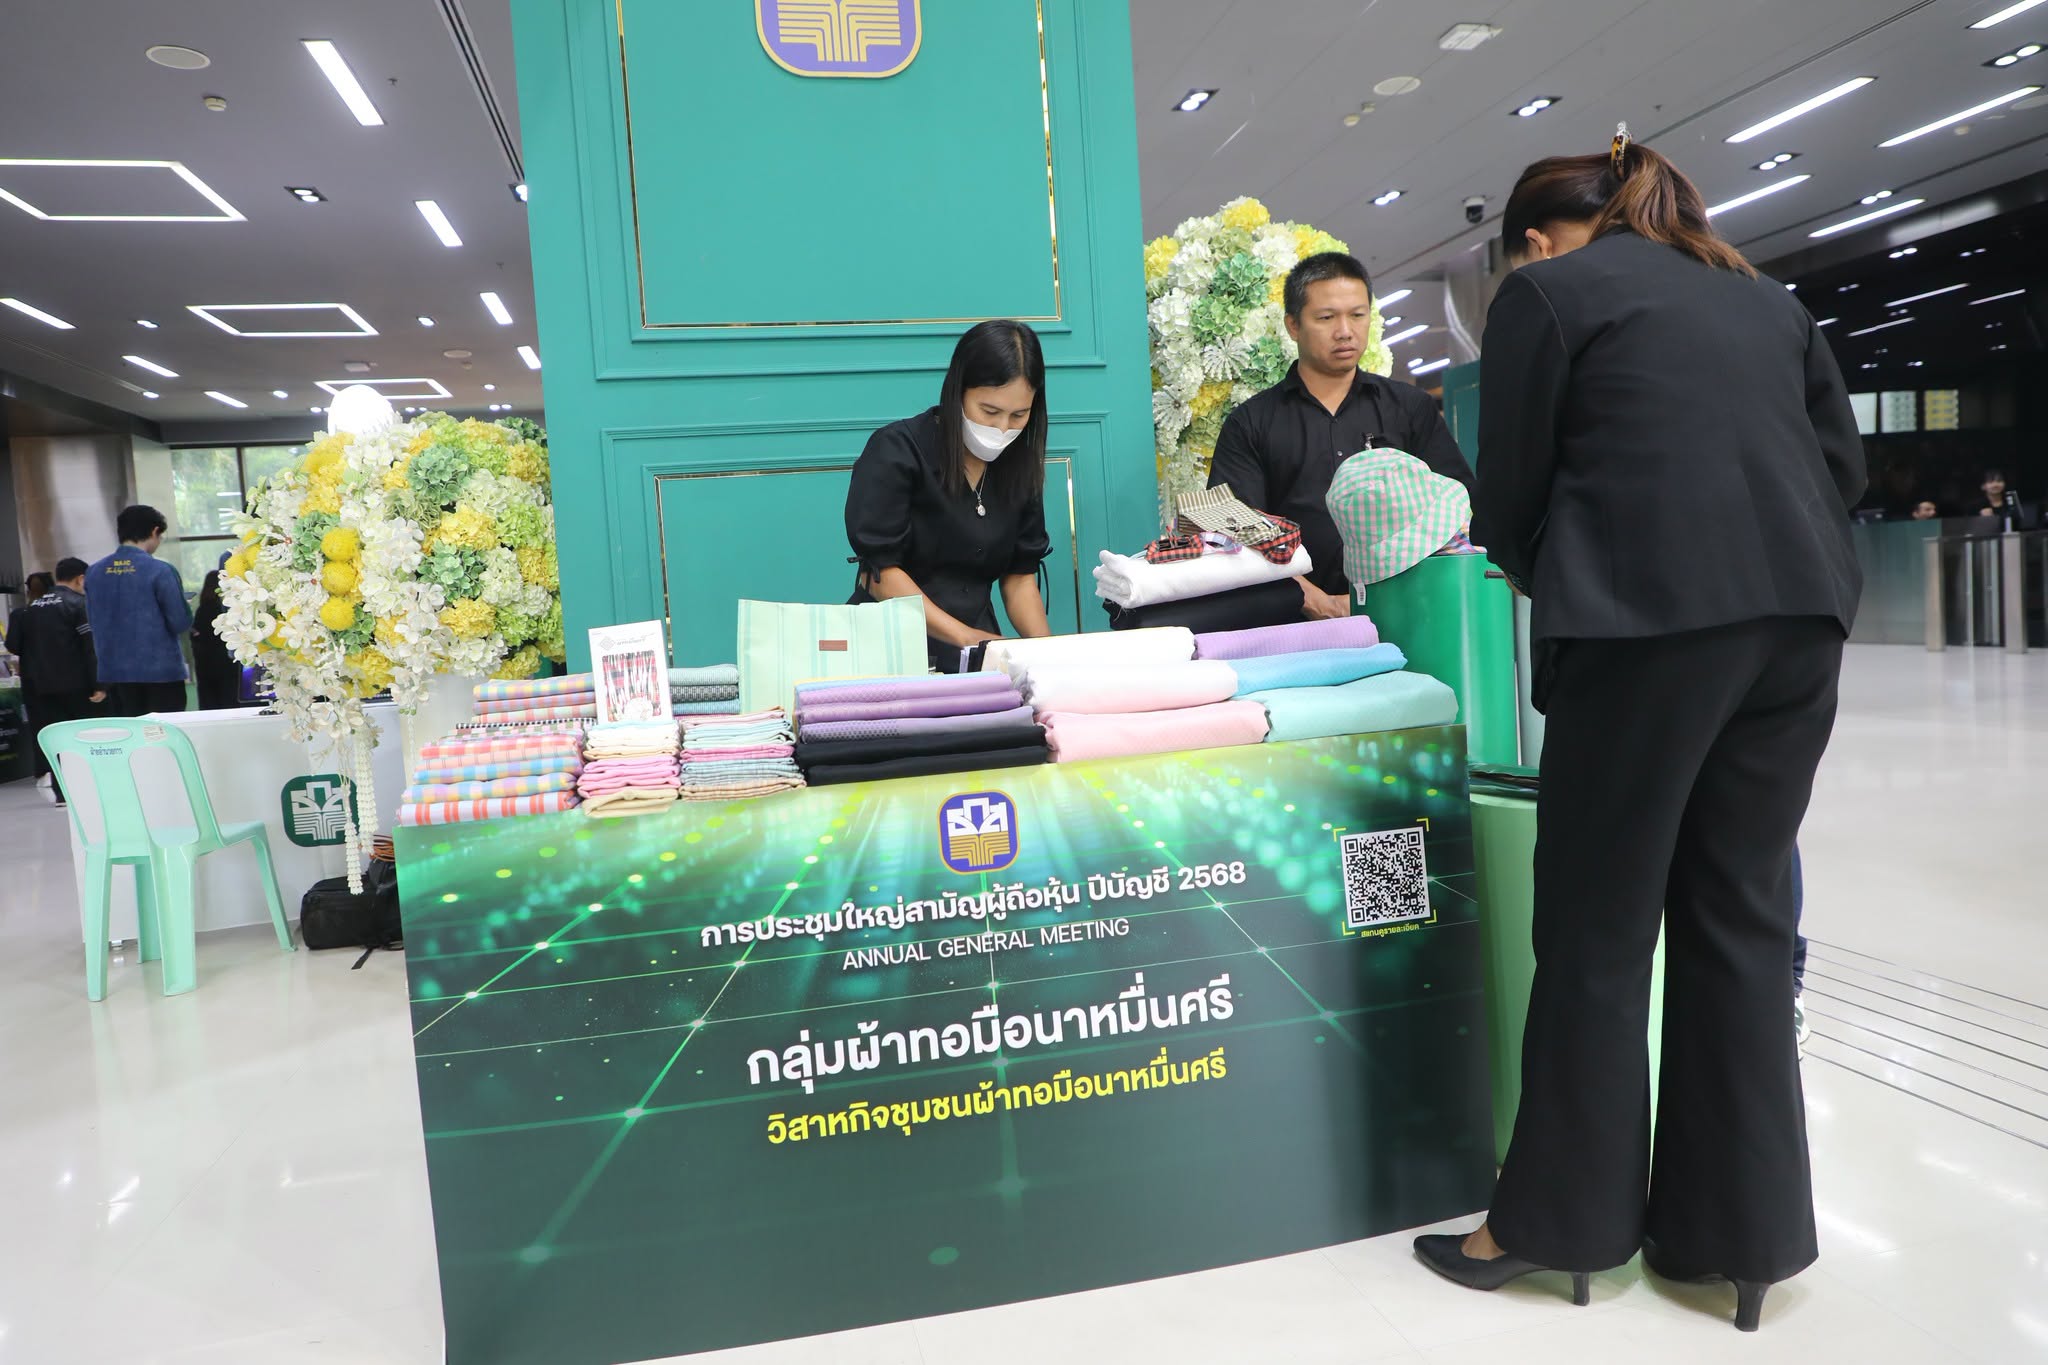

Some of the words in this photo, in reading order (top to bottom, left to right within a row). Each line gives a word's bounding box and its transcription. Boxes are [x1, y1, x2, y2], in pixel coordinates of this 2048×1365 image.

[701, 876, 1081, 947] การประชุมใหญ่สามัญผู้ถือหุ้น
[1088, 866, 1170, 900] ปีบัญชี
[1177, 861, 1246, 891] 2568
[843, 941, 931, 970] ANNUAL
[938, 928, 1034, 959] GENERAL
[1040, 918, 1130, 946] MEETING
[1361, 923, 1420, 938] สแกนดูรายละเอียด
[746, 972, 1234, 1094] กลุ่มผ้าทอมือนาหมื่นศรี
[766, 1047, 1227, 1144] วิสาหกิจชุมชนผ้าทอมือนาหมื่นศรี
